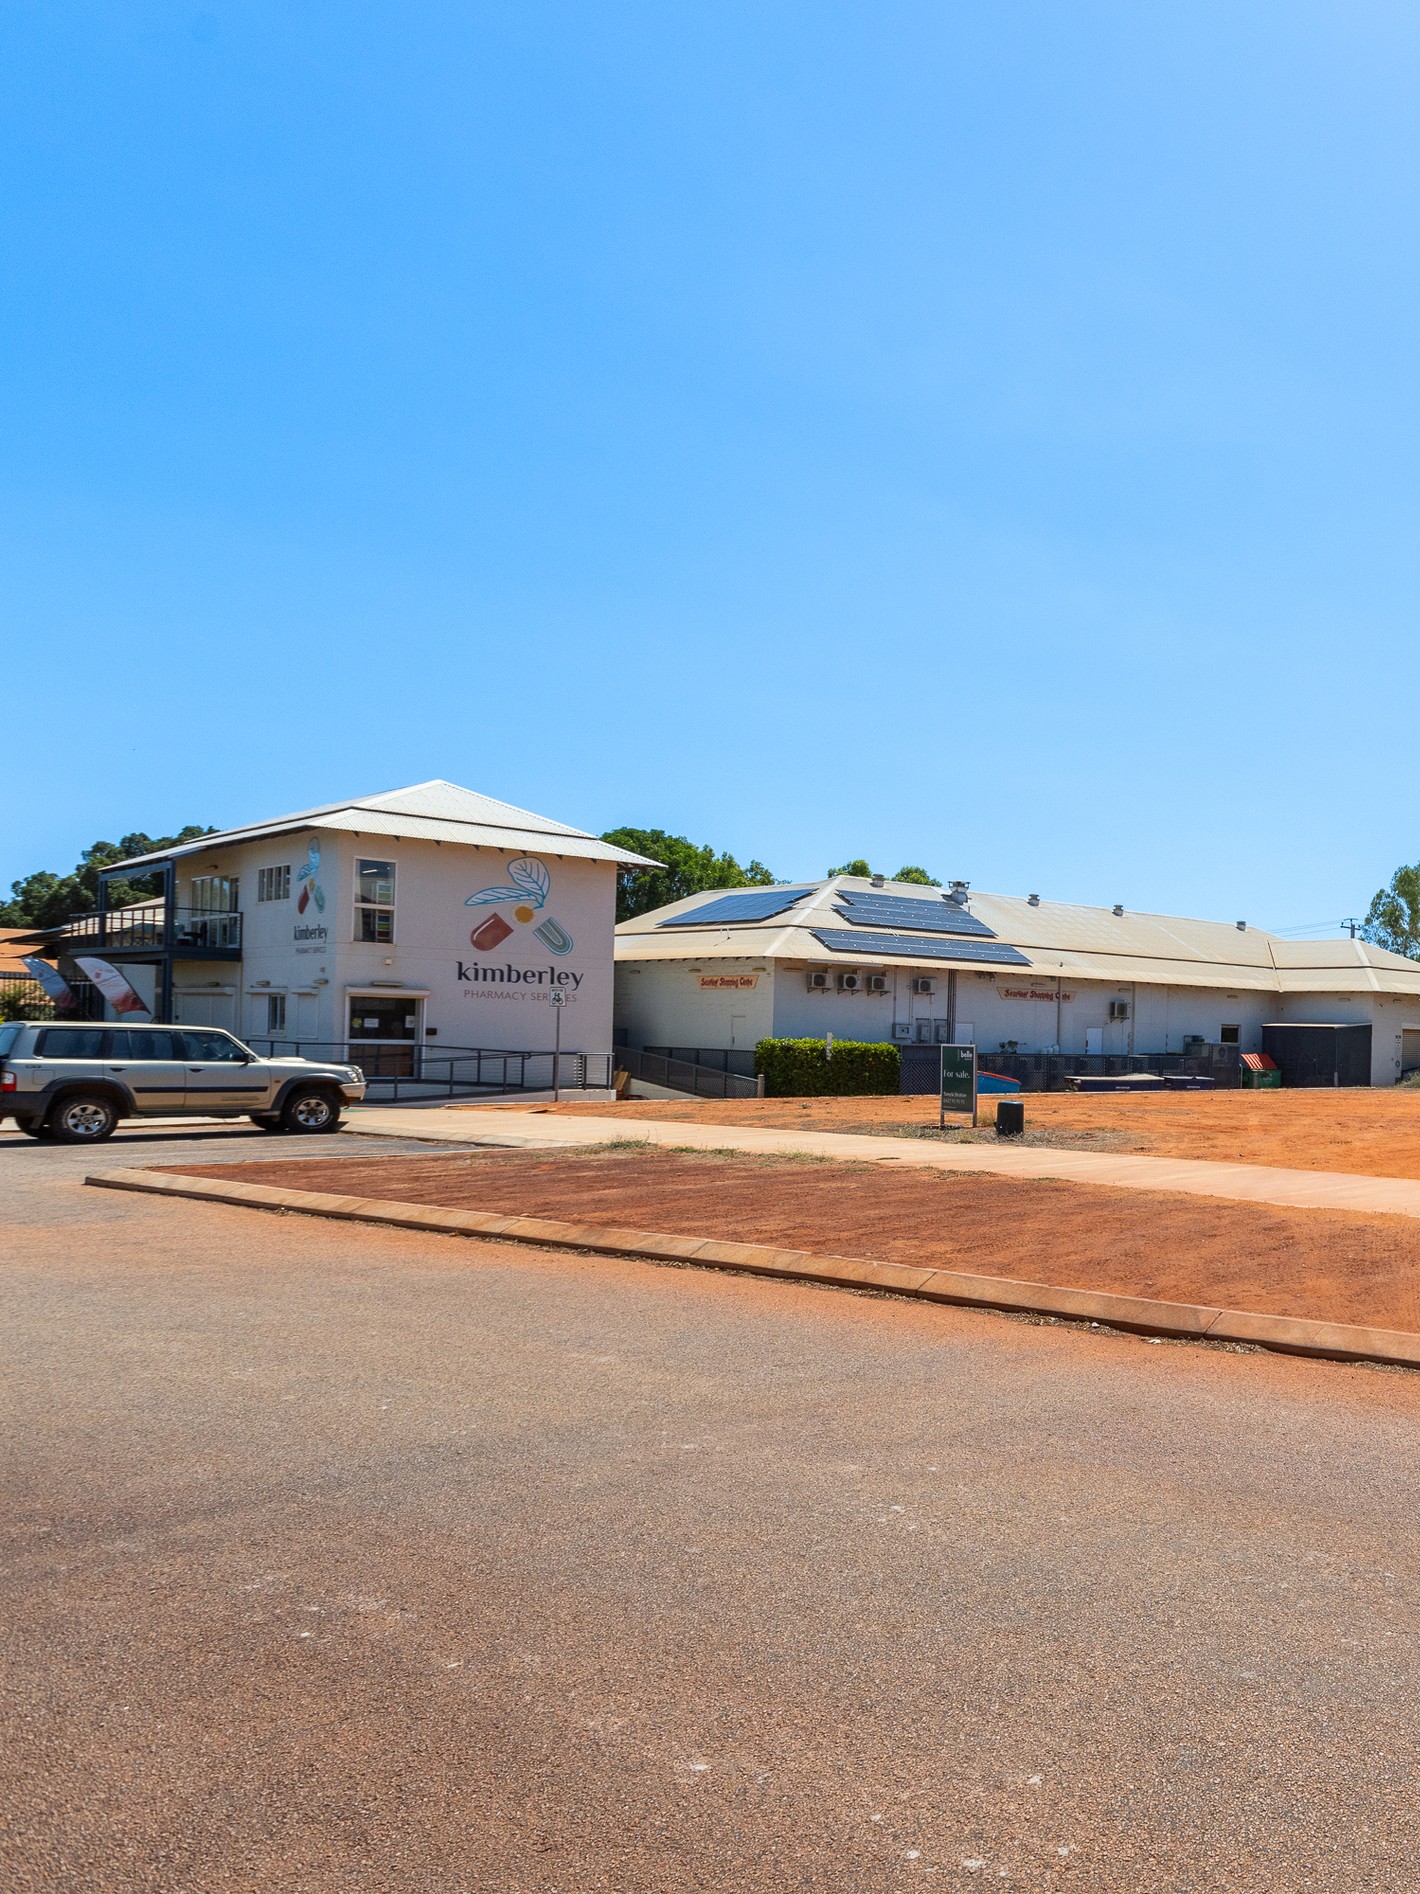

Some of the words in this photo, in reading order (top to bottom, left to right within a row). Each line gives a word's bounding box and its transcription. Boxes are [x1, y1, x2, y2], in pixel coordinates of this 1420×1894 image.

[456, 961, 584, 991] kimberley
[719, 977, 739, 988] Shopping
[464, 989, 527, 1000] PHARMACY
[531, 992, 577, 1002] SERES
[1029, 990, 1054, 1001] Shopping
[960, 1050, 973, 1058] belle
[943, 1069, 954, 1078] For
[955, 1070, 971, 1078] sale.
